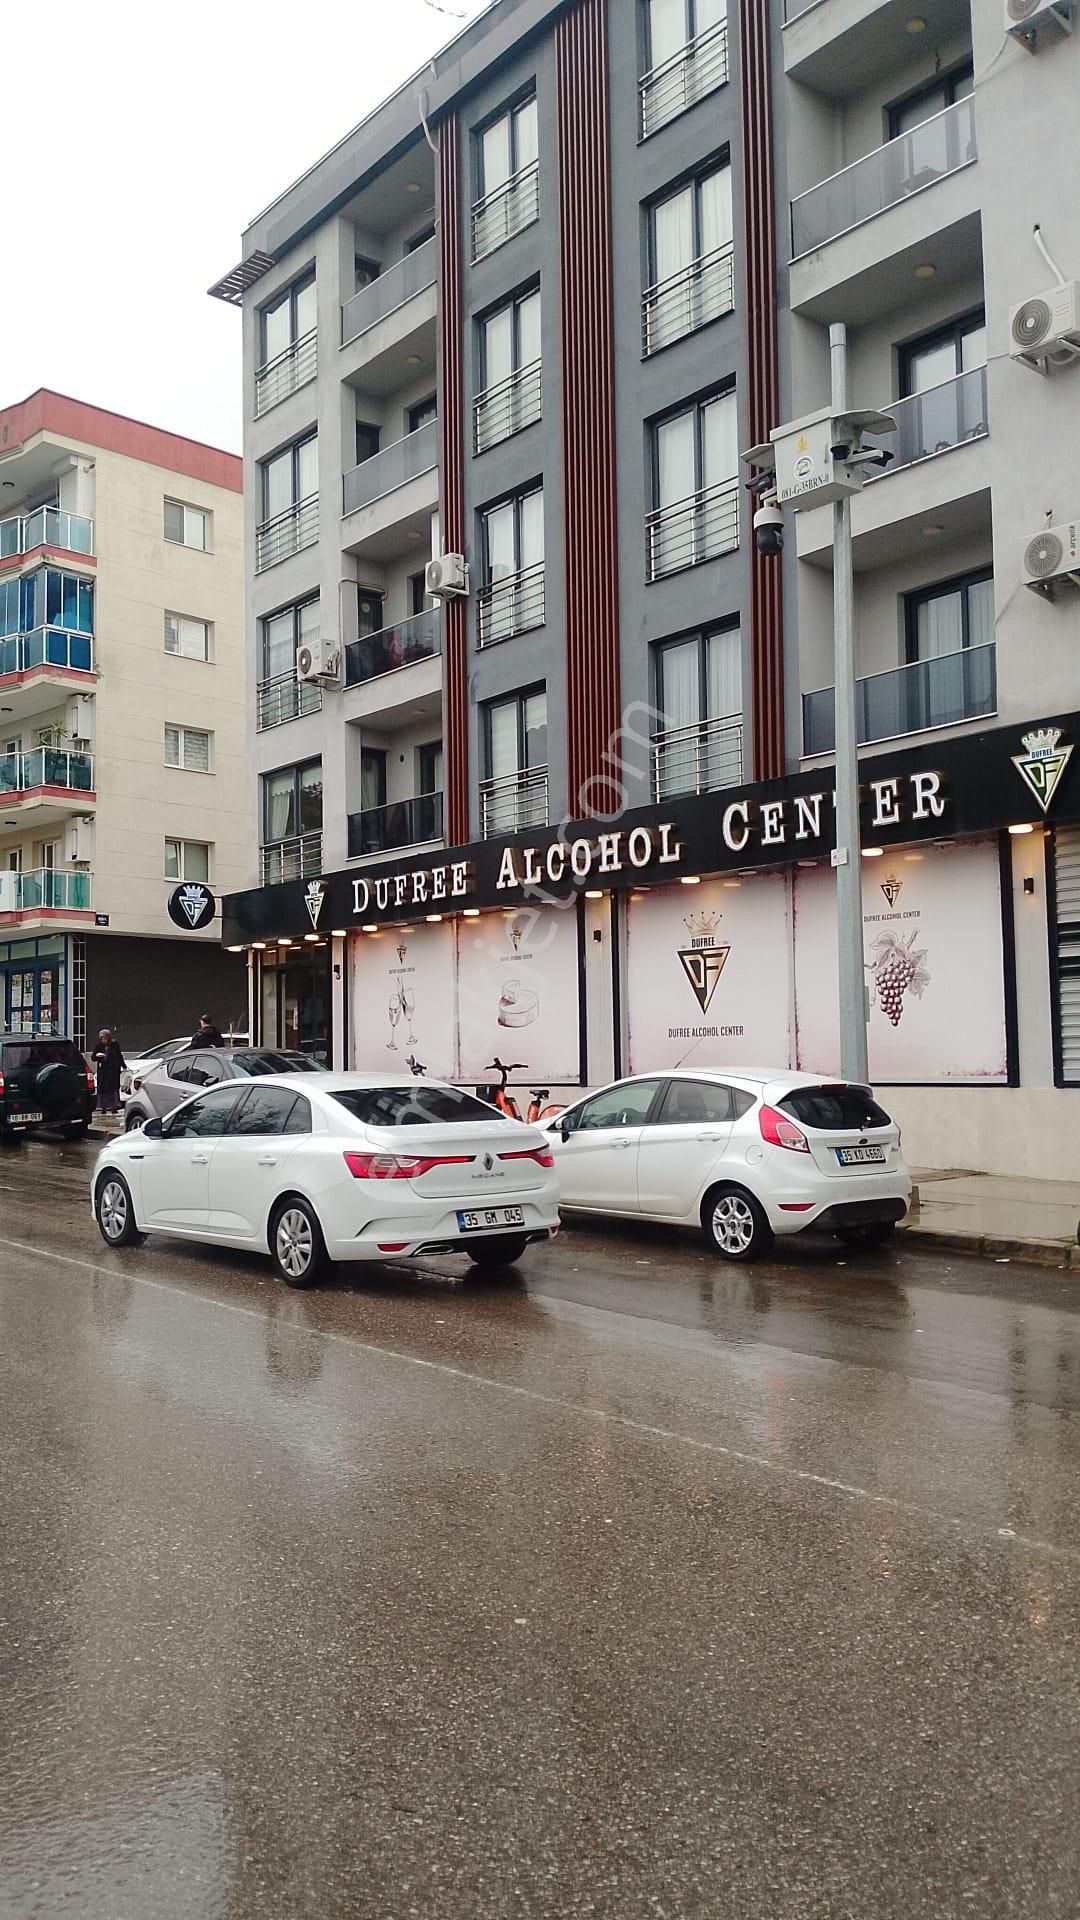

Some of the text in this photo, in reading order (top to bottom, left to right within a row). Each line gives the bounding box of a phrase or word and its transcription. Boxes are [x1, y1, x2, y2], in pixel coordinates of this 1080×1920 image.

[1031, 747, 1053, 759] DUFREE
[352, 771, 945, 913] DUFREE ALCOHOL CENER
[691, 936, 715, 948] DUFREE
[668, 1025, 744, 1038] DUFREE ALCOHOL CENTER
[842, 1150, 853, 1161] 35
[464, 1208, 522, 1227] 35 GM 045
